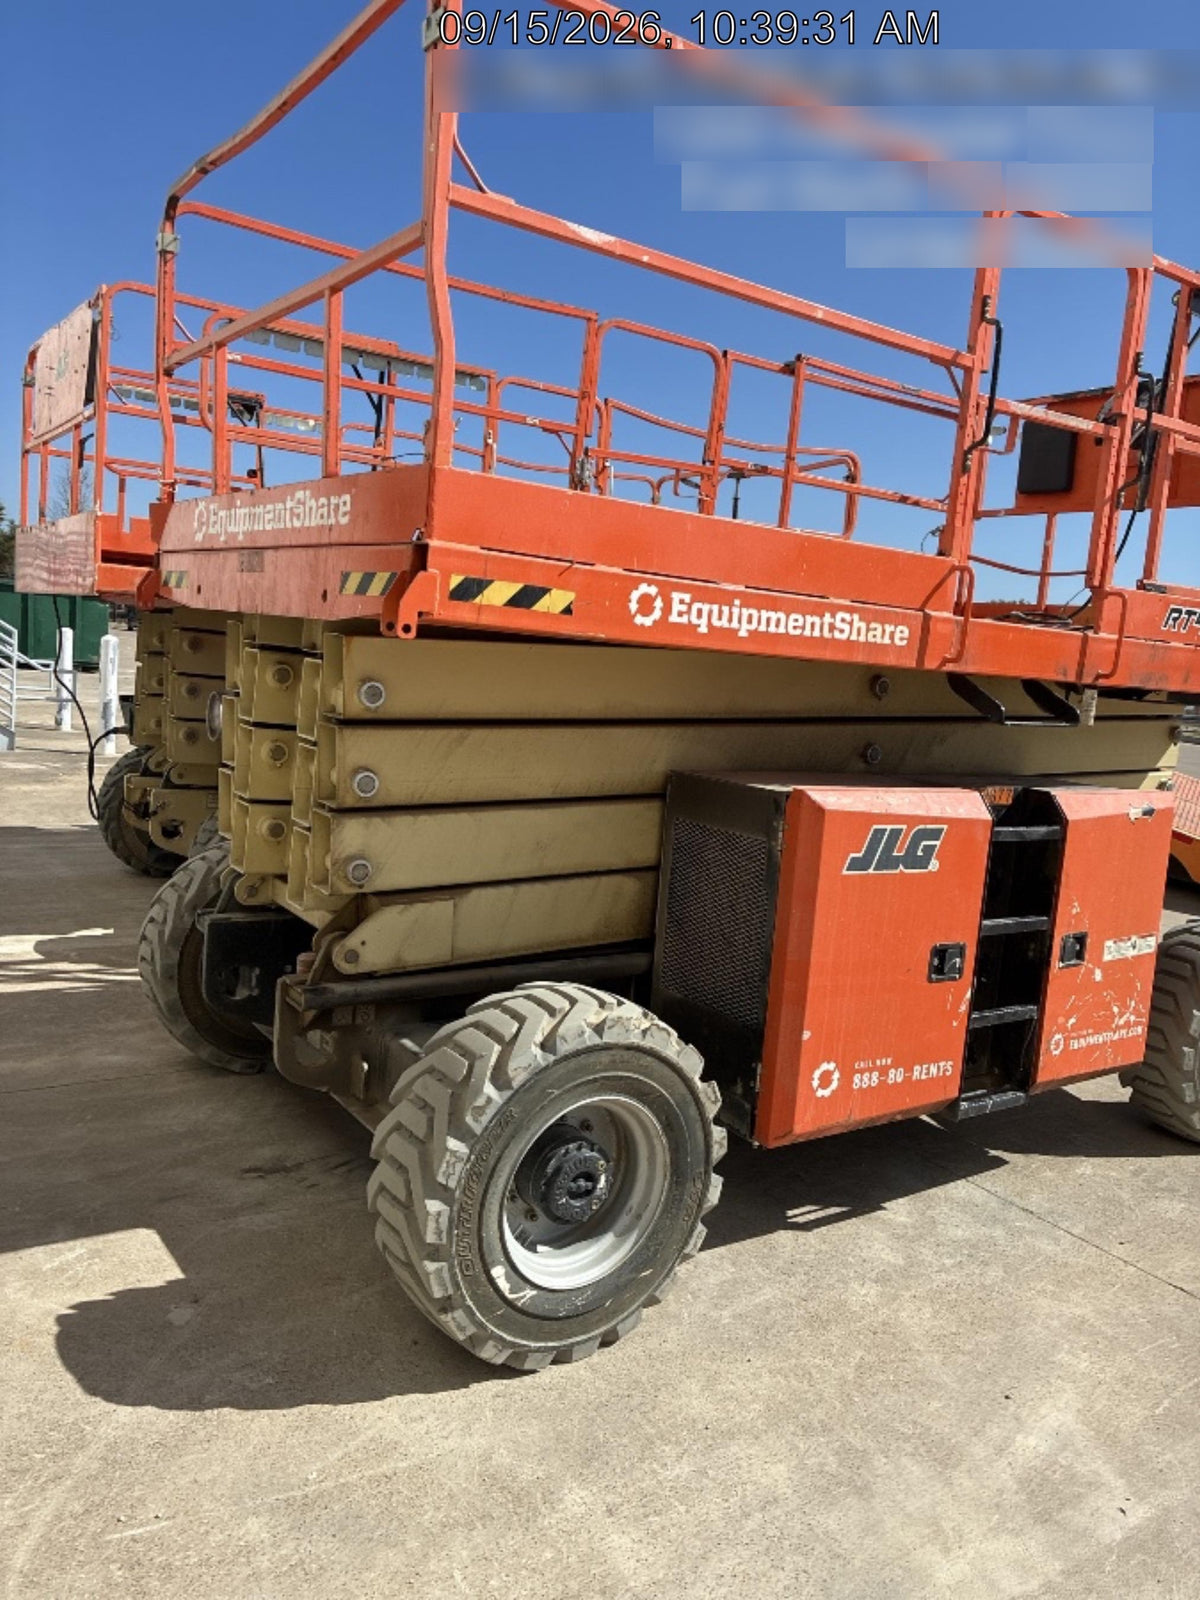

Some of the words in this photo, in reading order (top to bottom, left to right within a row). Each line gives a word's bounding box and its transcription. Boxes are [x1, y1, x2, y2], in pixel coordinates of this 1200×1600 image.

[208, 490, 352, 542] EquipmentShare
[668, 591, 909, 646] EquipmentShare
[1162, 605, 1200, 633] RT
[842, 825, 948, 874] JLG
[852, 1061, 954, 1089] 888-80-RENTS
